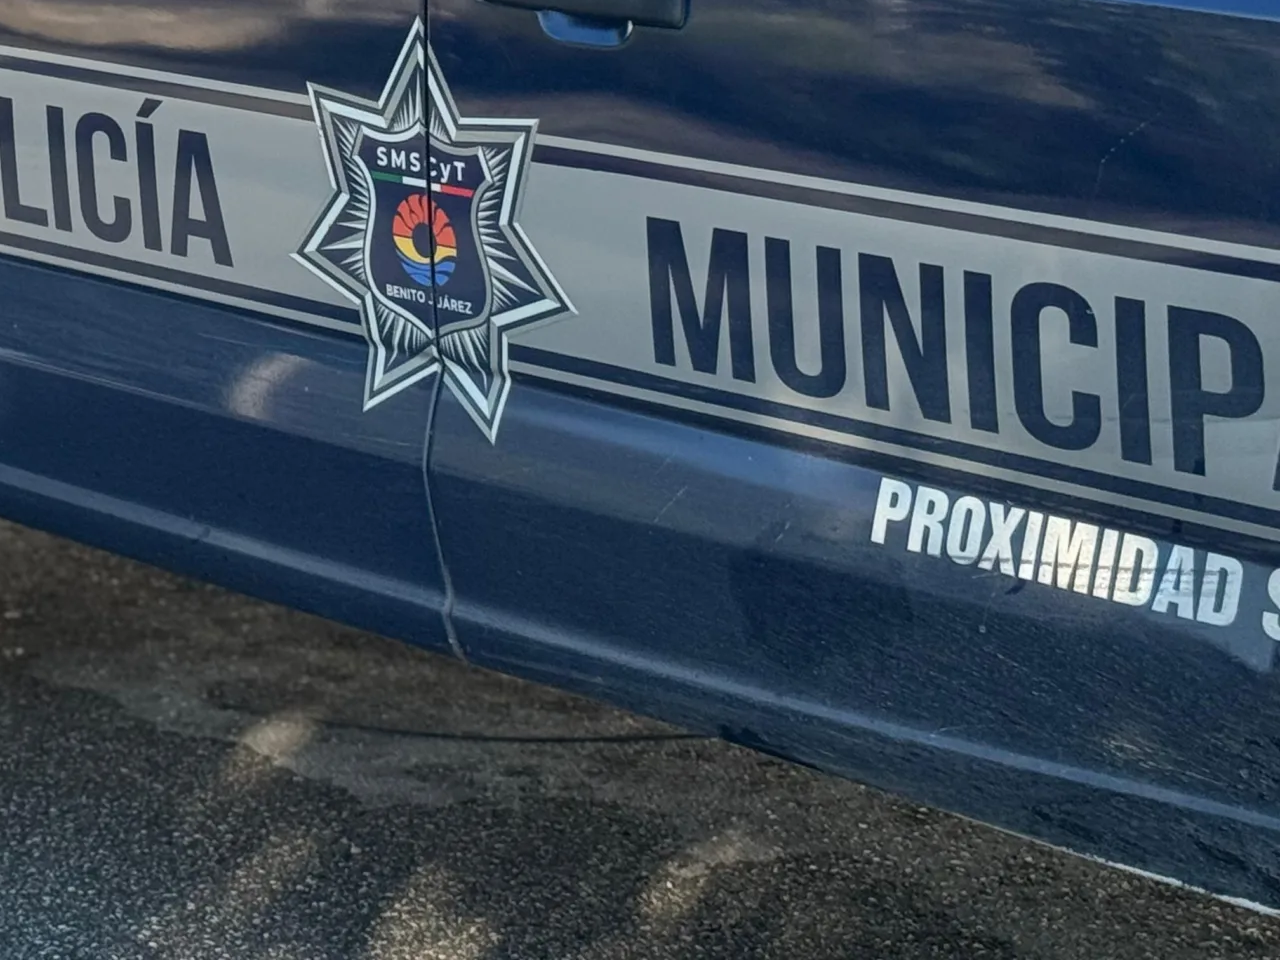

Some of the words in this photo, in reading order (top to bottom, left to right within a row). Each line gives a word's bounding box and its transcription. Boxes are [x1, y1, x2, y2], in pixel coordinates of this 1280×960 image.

[385, 283, 426, 304] BENITO
[646, 216, 1280, 492] MUNICIP
[870, 477, 1244, 627] PROXIMIDAD
